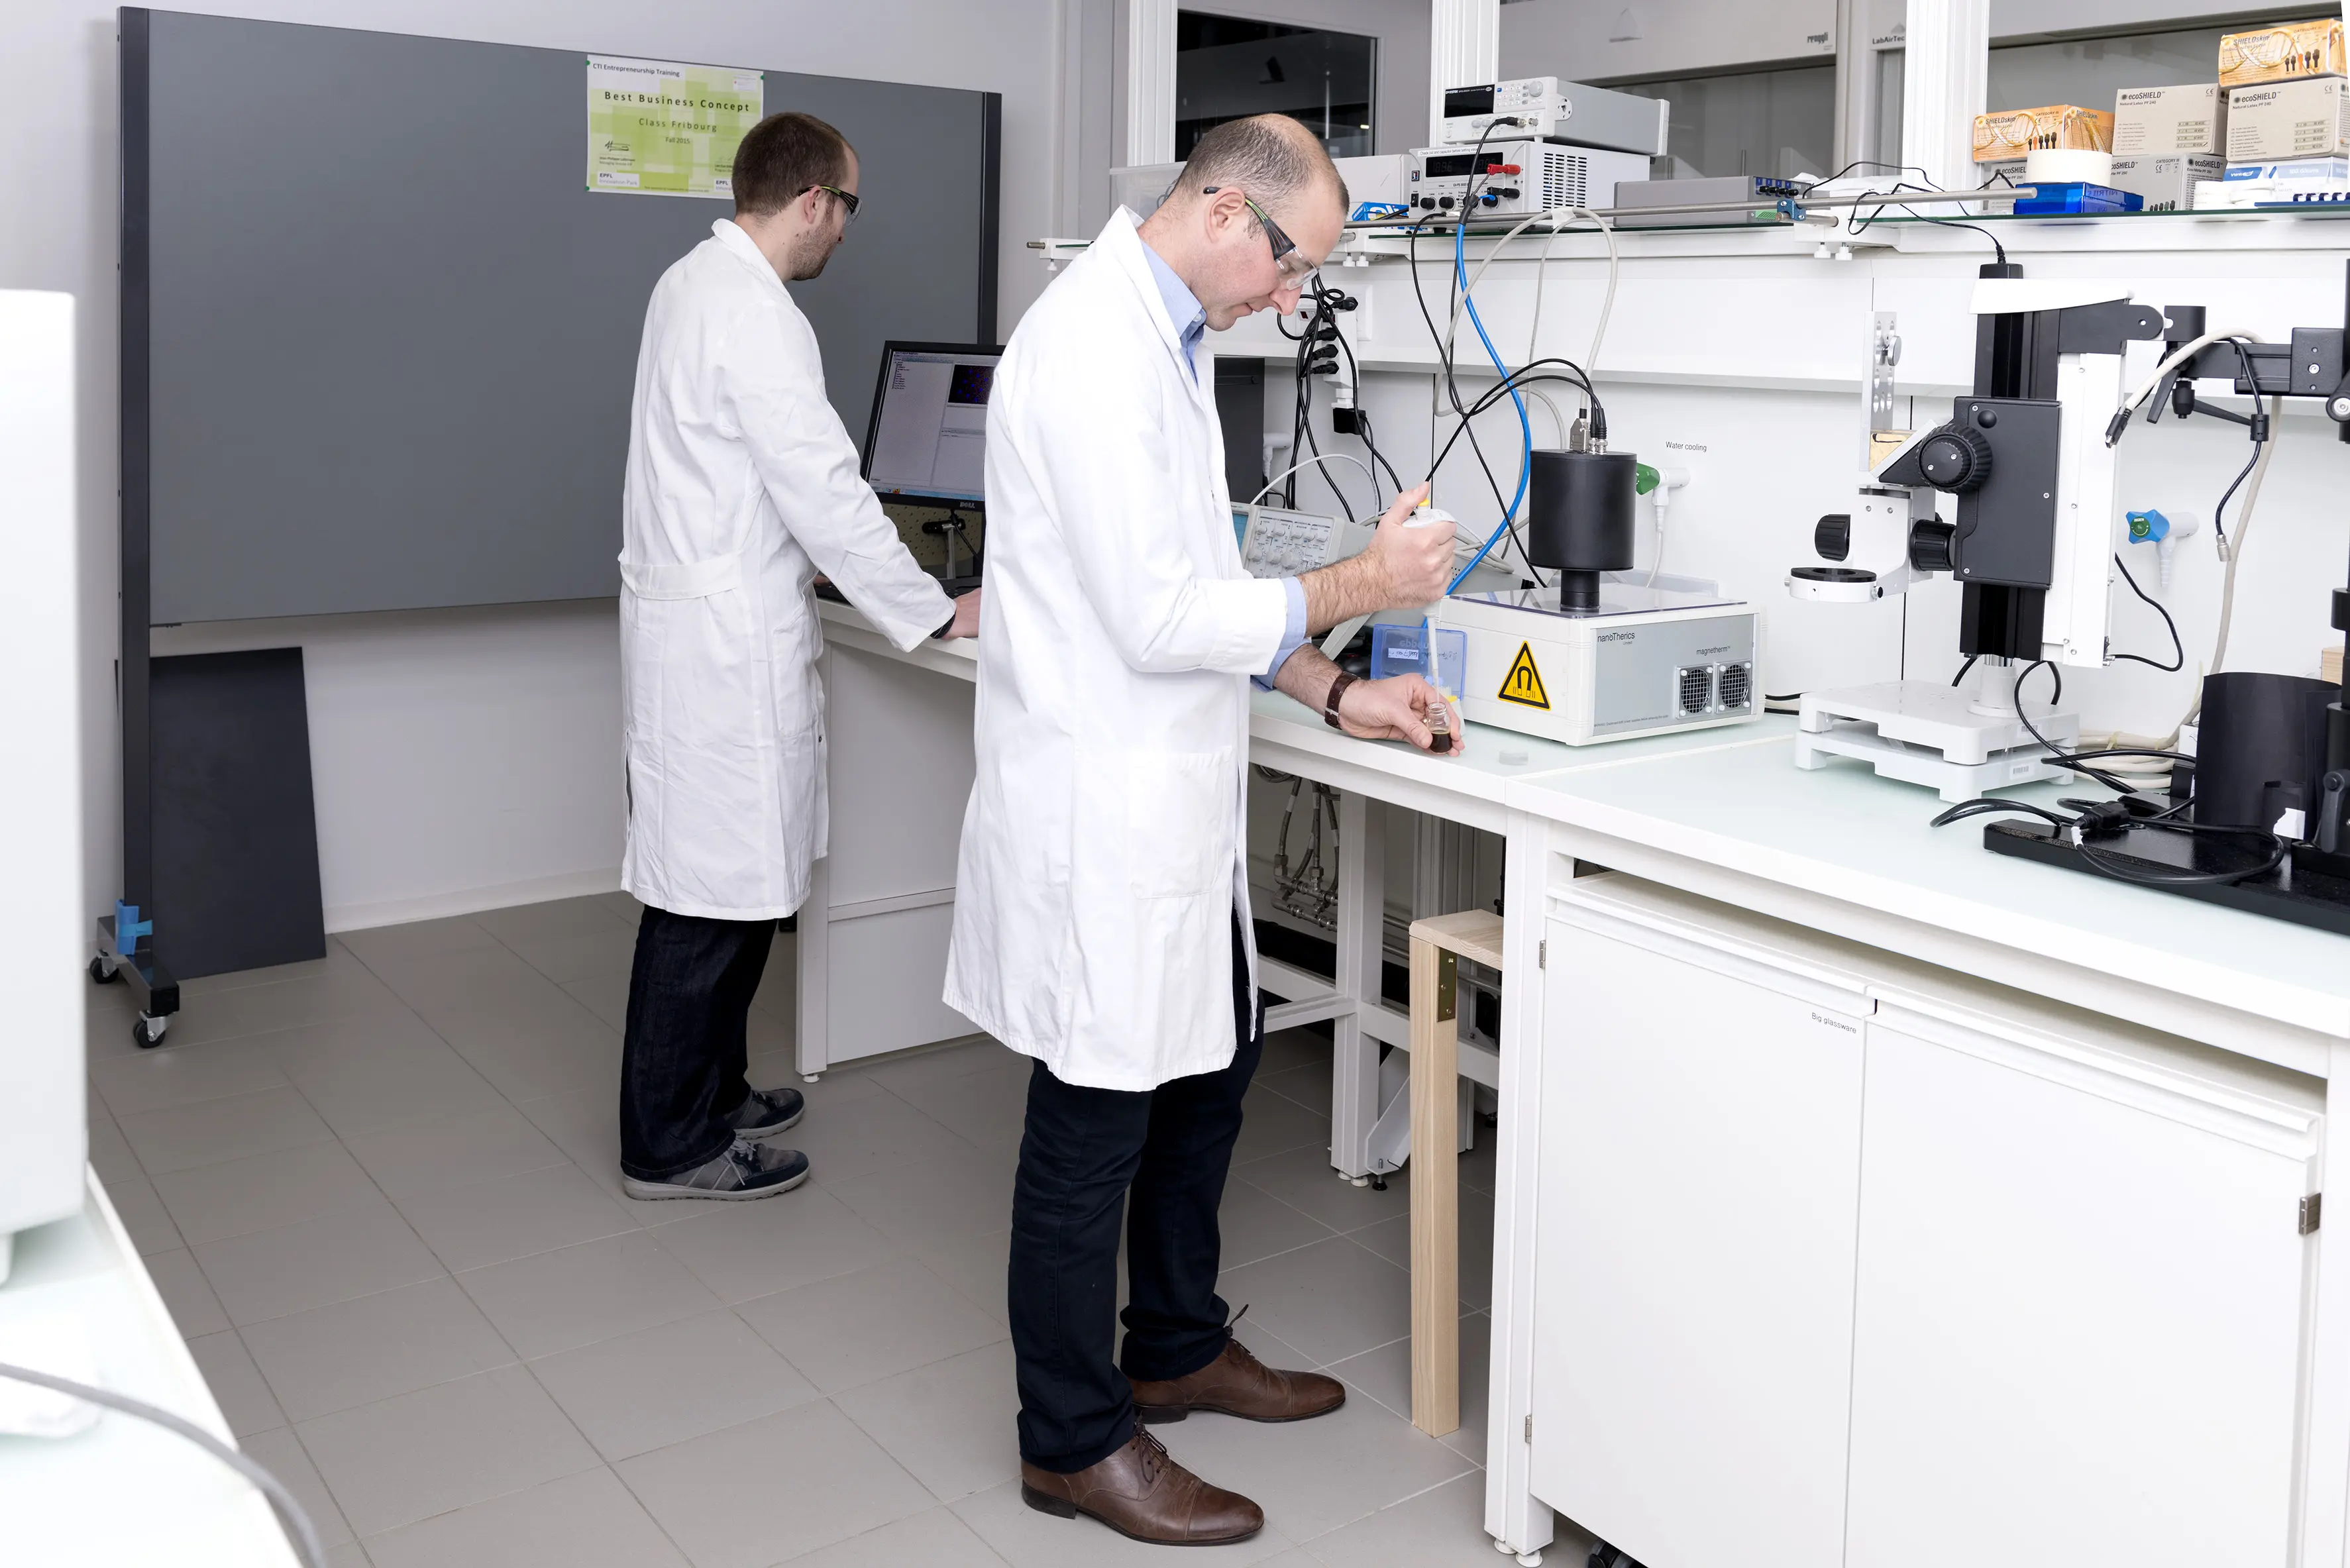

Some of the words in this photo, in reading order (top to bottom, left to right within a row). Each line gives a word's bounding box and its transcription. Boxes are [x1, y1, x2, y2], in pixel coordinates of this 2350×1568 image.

[2233, 35, 2269, 46] SHIELDskin
[604, 64, 655, 75] Entrepreneurship
[657, 69, 680, 78] Training
[605, 91, 631, 101] Best
[639, 94, 694, 107] Business
[700, 99, 749, 113] Concept
[639, 118, 666, 128] Class
[671, 121, 717, 132] Fribourg
[1666, 441, 1683, 450] Water
[1685, 442, 1707, 452] cooling
[1811, 1012, 1822, 1022] Big
[1823, 1017, 1856, 1034] glassware
